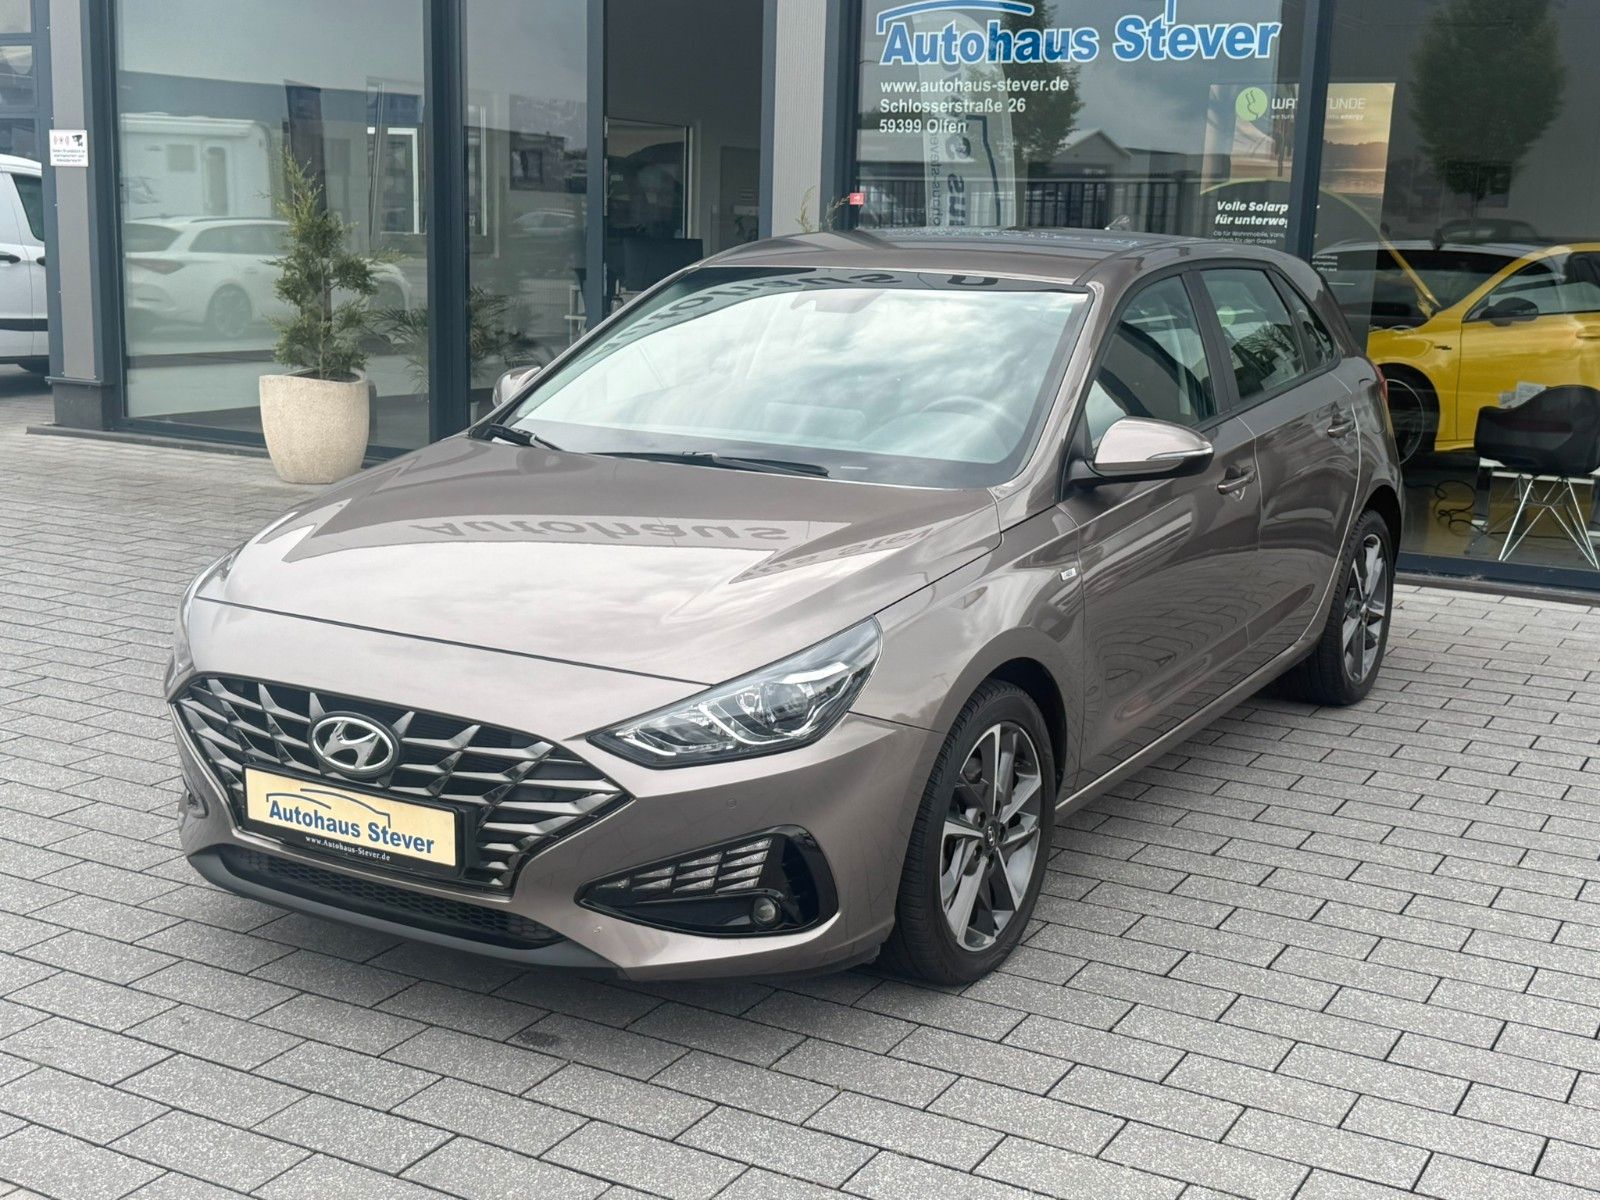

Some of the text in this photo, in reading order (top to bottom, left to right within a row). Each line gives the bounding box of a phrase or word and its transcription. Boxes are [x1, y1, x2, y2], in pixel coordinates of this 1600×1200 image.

[880, 14, 1282, 65] Autohaus Stever
[880, 76, 1069, 93] www.autohaus-stever.de
[880, 98, 1026, 113] Schlosserstraße 26
[879, 118, 967, 133] 59399 Olfen
[1217, 201, 1289, 215] Volle Solarp
[1215, 213, 1288, 229] für unterwe
[269, 799, 435, 854] Autohaus Stever
[305, 835, 391, 862] www.Autohaus-Stever.de
